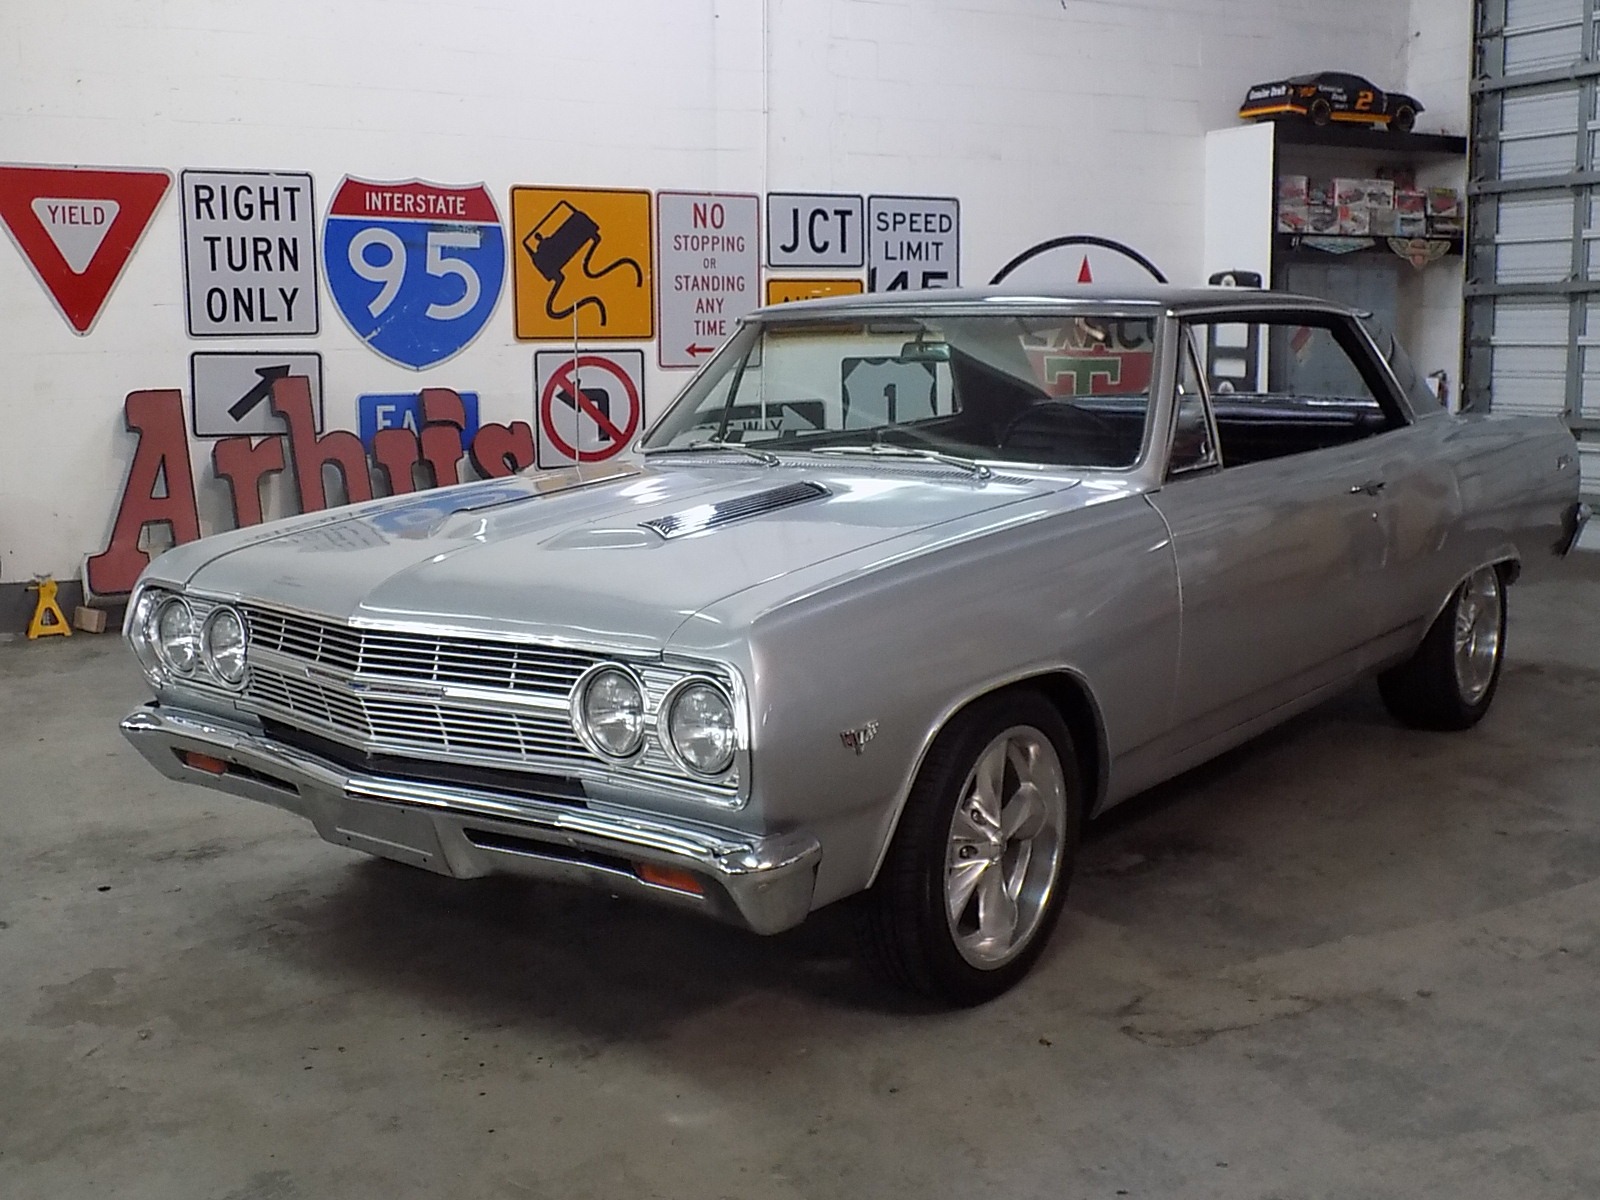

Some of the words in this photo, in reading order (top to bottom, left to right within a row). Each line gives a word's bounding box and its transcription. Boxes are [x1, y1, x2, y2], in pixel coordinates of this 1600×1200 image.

[1355, 89, 1374, 111] 2
[194, 184, 302, 222] RIGHT
[364, 190, 467, 216] INTERSTATE
[47, 205, 106, 226] YIELD
[693, 202, 725, 230] NO
[876, 211, 953, 234] SPEED
[779, 207, 853, 254] JCT
[203, 236, 300, 272] TURN
[673, 234, 746, 253] STOPPING
[884, 240, 944, 262] LIMIT
[347, 227, 481, 321] 95
[702, 257, 717, 270] OR
[674, 274, 746, 293] STANDING
[206, 286, 301, 323] ONLY
[695, 297, 725, 314] ANY
[693, 319, 727, 337] TIME
[883, 383, 897, 425] 1
